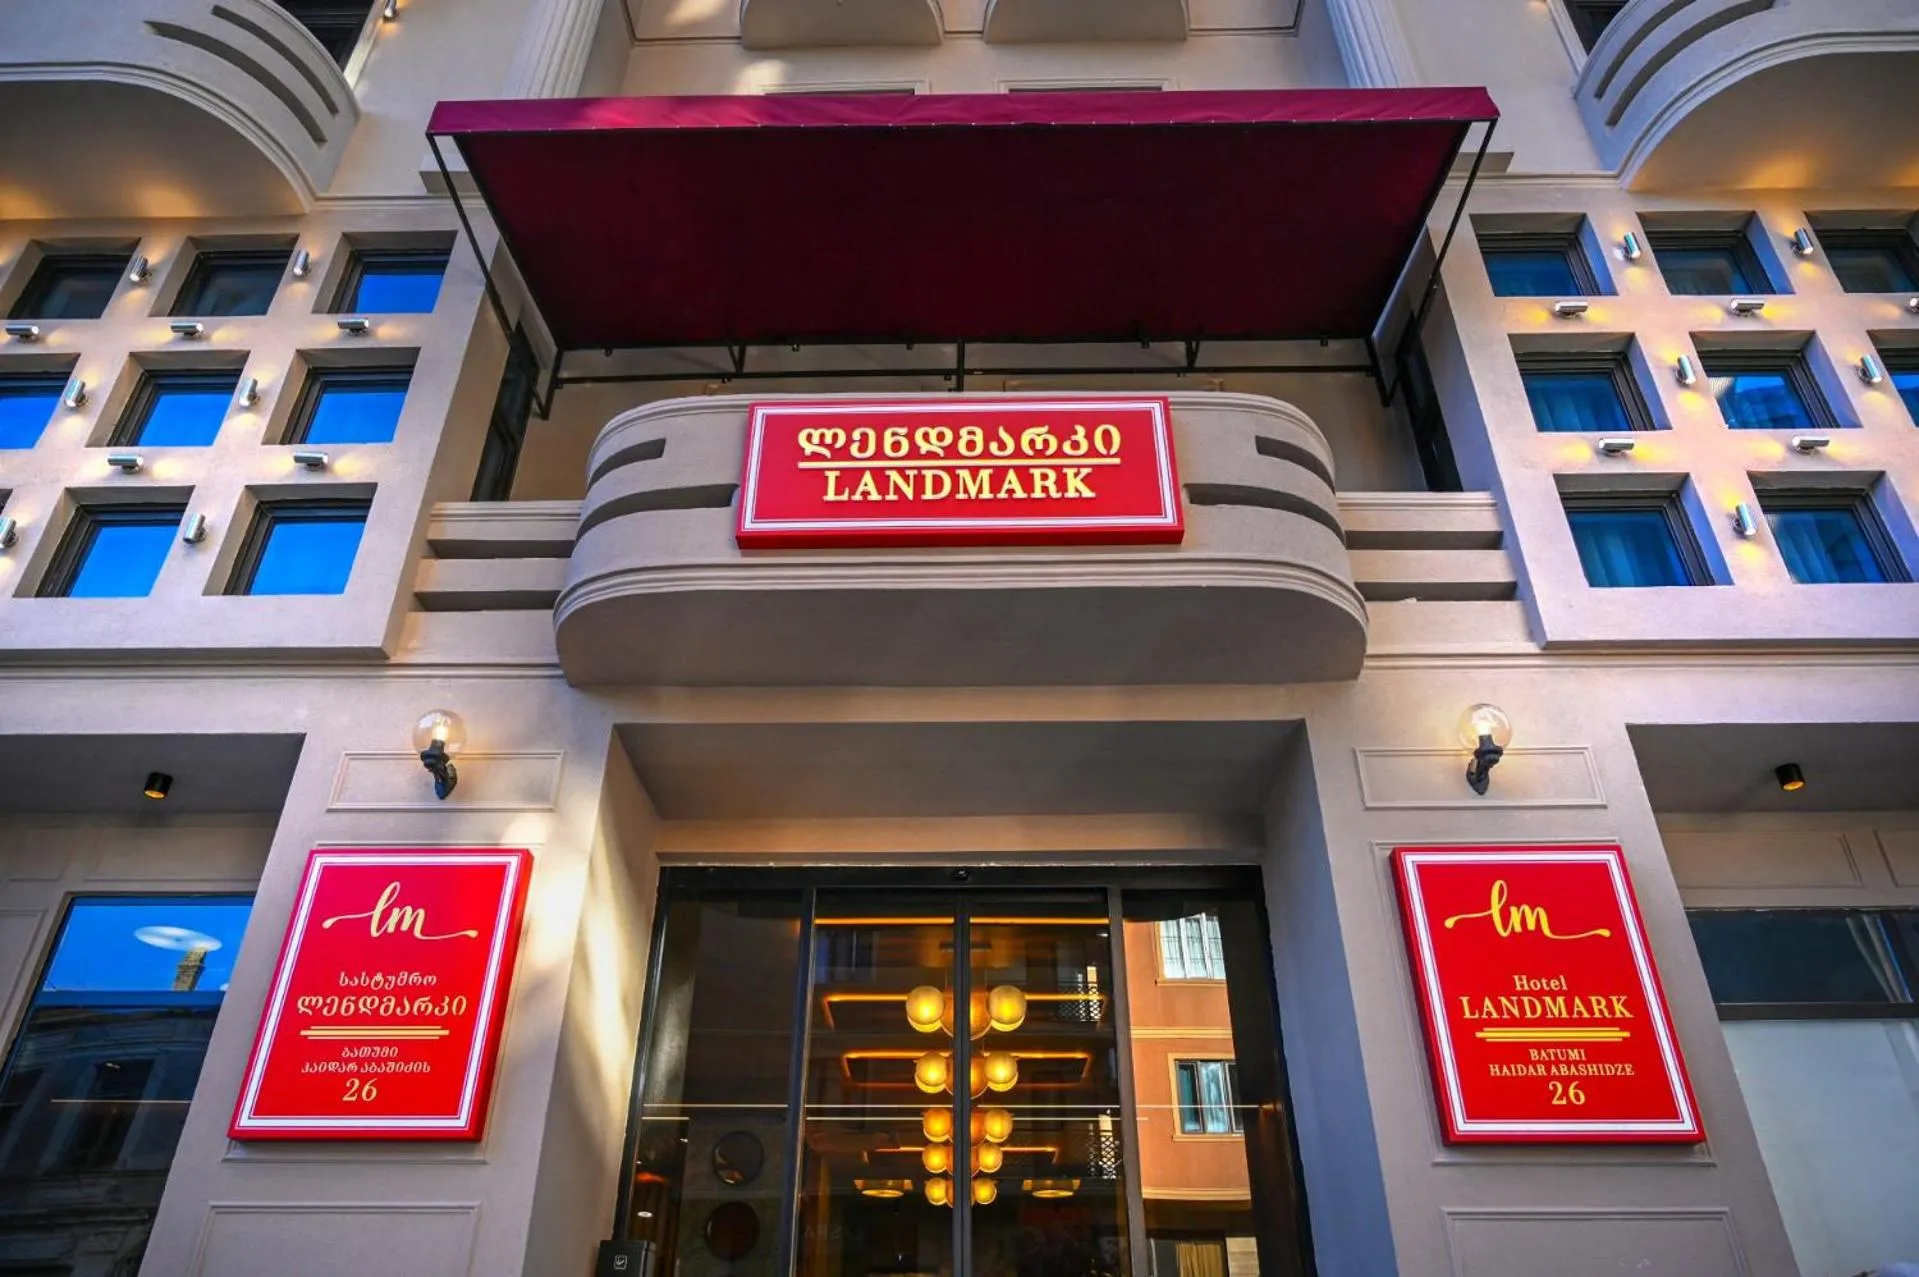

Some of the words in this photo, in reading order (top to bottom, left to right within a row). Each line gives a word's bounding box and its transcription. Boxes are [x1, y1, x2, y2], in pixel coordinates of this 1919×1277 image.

[797, 424, 1122, 459] ლენდმარკი
[822, 467, 1096, 502] LANDMARK
[338, 971, 437, 991] სასტუმრო
[1513, 974, 1568, 992] Hotel
[296, 995, 467, 1017] ლენდმარკი
[1459, 995, 1634, 1019] LANDMARK
[341, 1046, 399, 1059] ბათუმი
[1528, 1048, 1588, 1061] BATUMI
[1488, 1063, 1548, 1077] HAIDAR
[1550, 1063, 1636, 1077] ABASHIDZE
[342, 1077, 378, 1102] 26
[1548, 1080, 1586, 1105] 26
